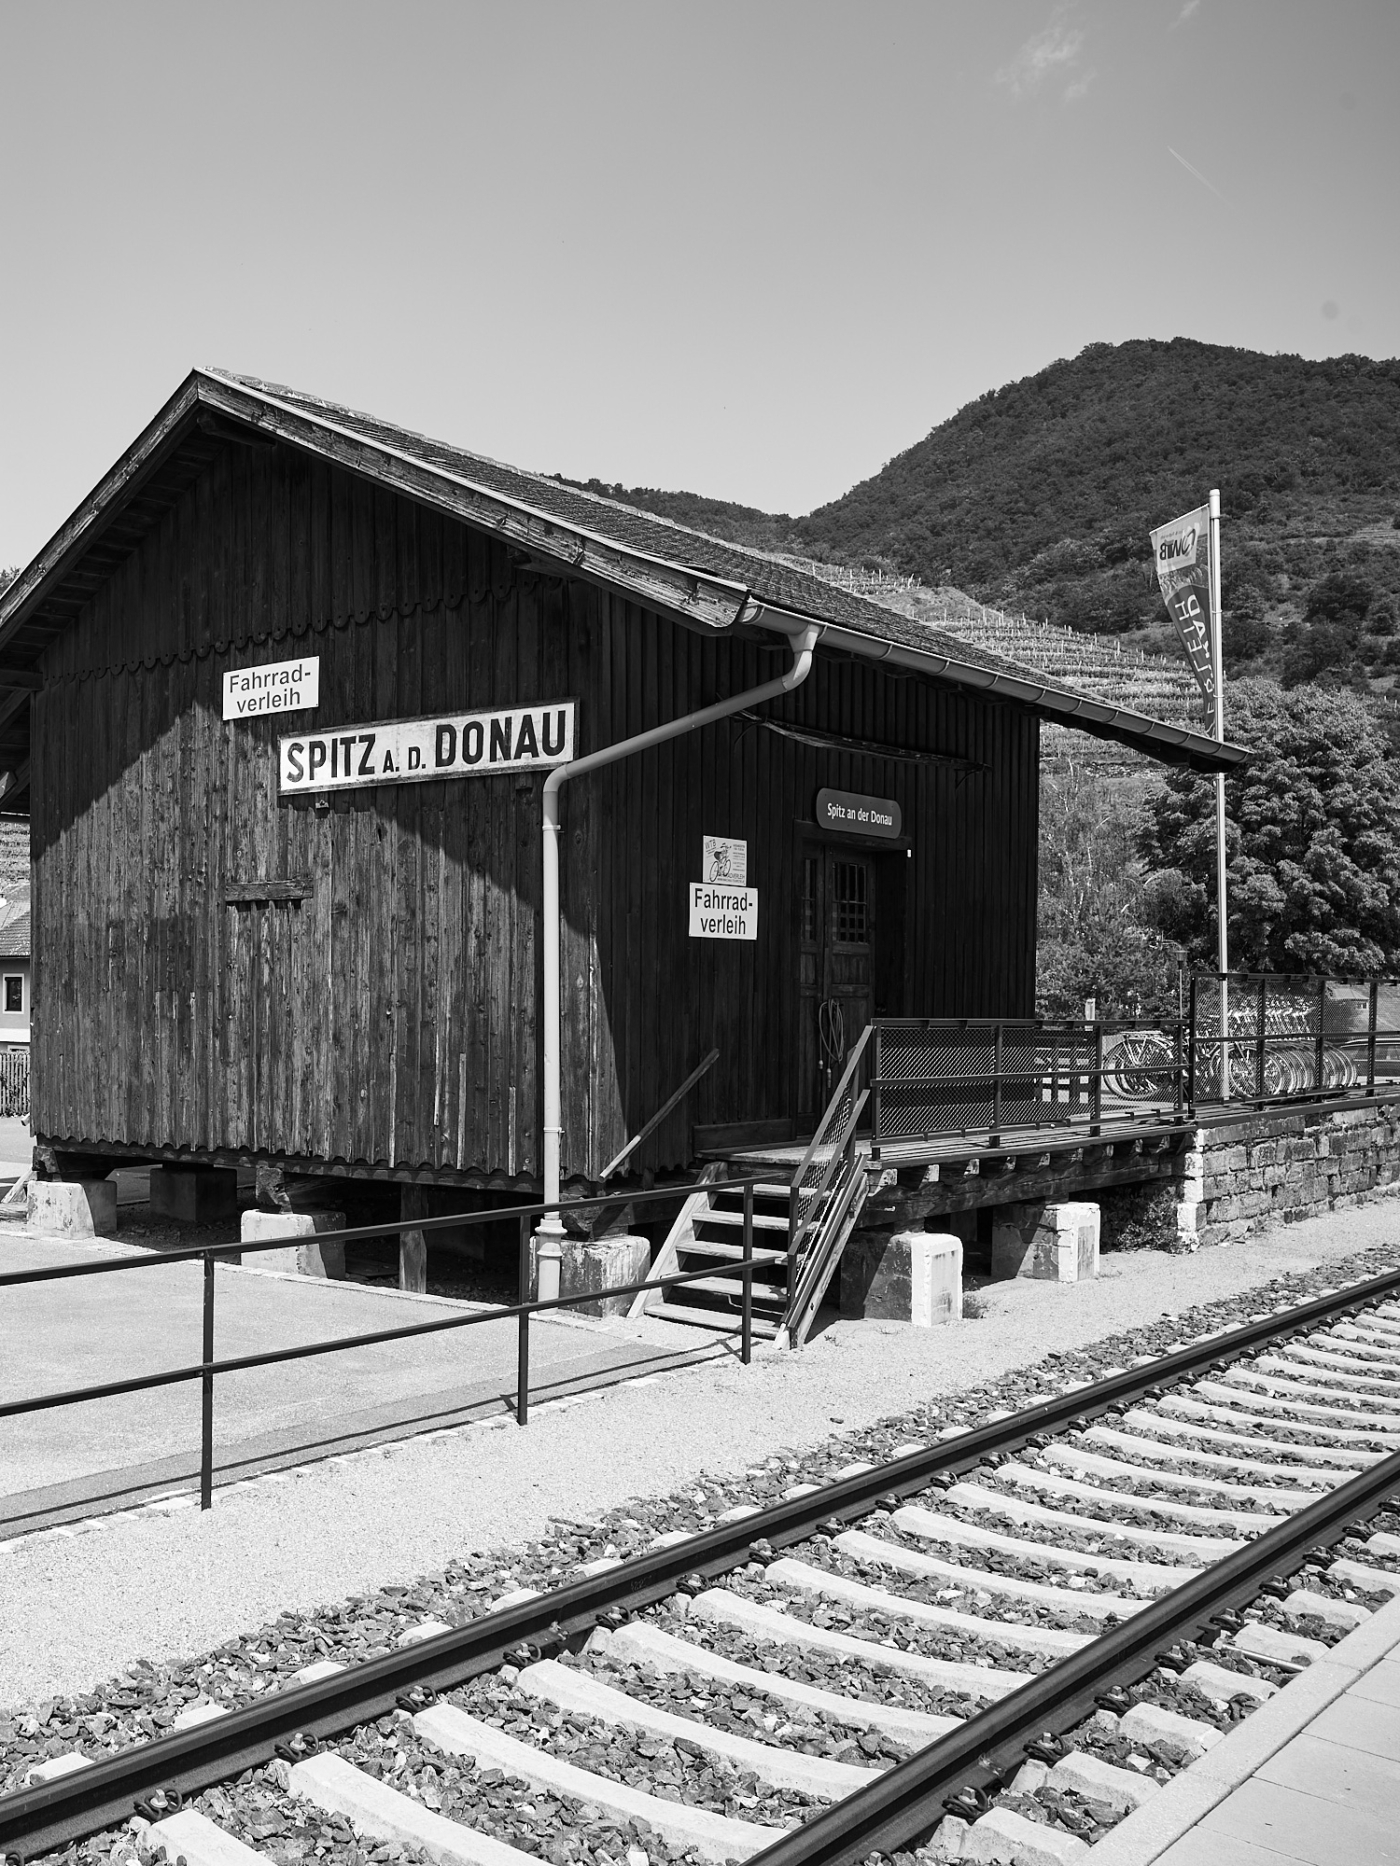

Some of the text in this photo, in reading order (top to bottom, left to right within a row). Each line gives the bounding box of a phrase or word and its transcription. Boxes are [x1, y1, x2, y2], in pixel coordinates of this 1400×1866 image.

[230, 663, 311, 693] Fahrrad-
[236, 687, 301, 713] verleih
[286, 710, 567, 783] SPITZ A. D. DONAU
[827, 802, 893, 826] Spitz an der Donau
[695, 887, 753, 911] Fahrrad-
[700, 914, 746, 935] verleih
